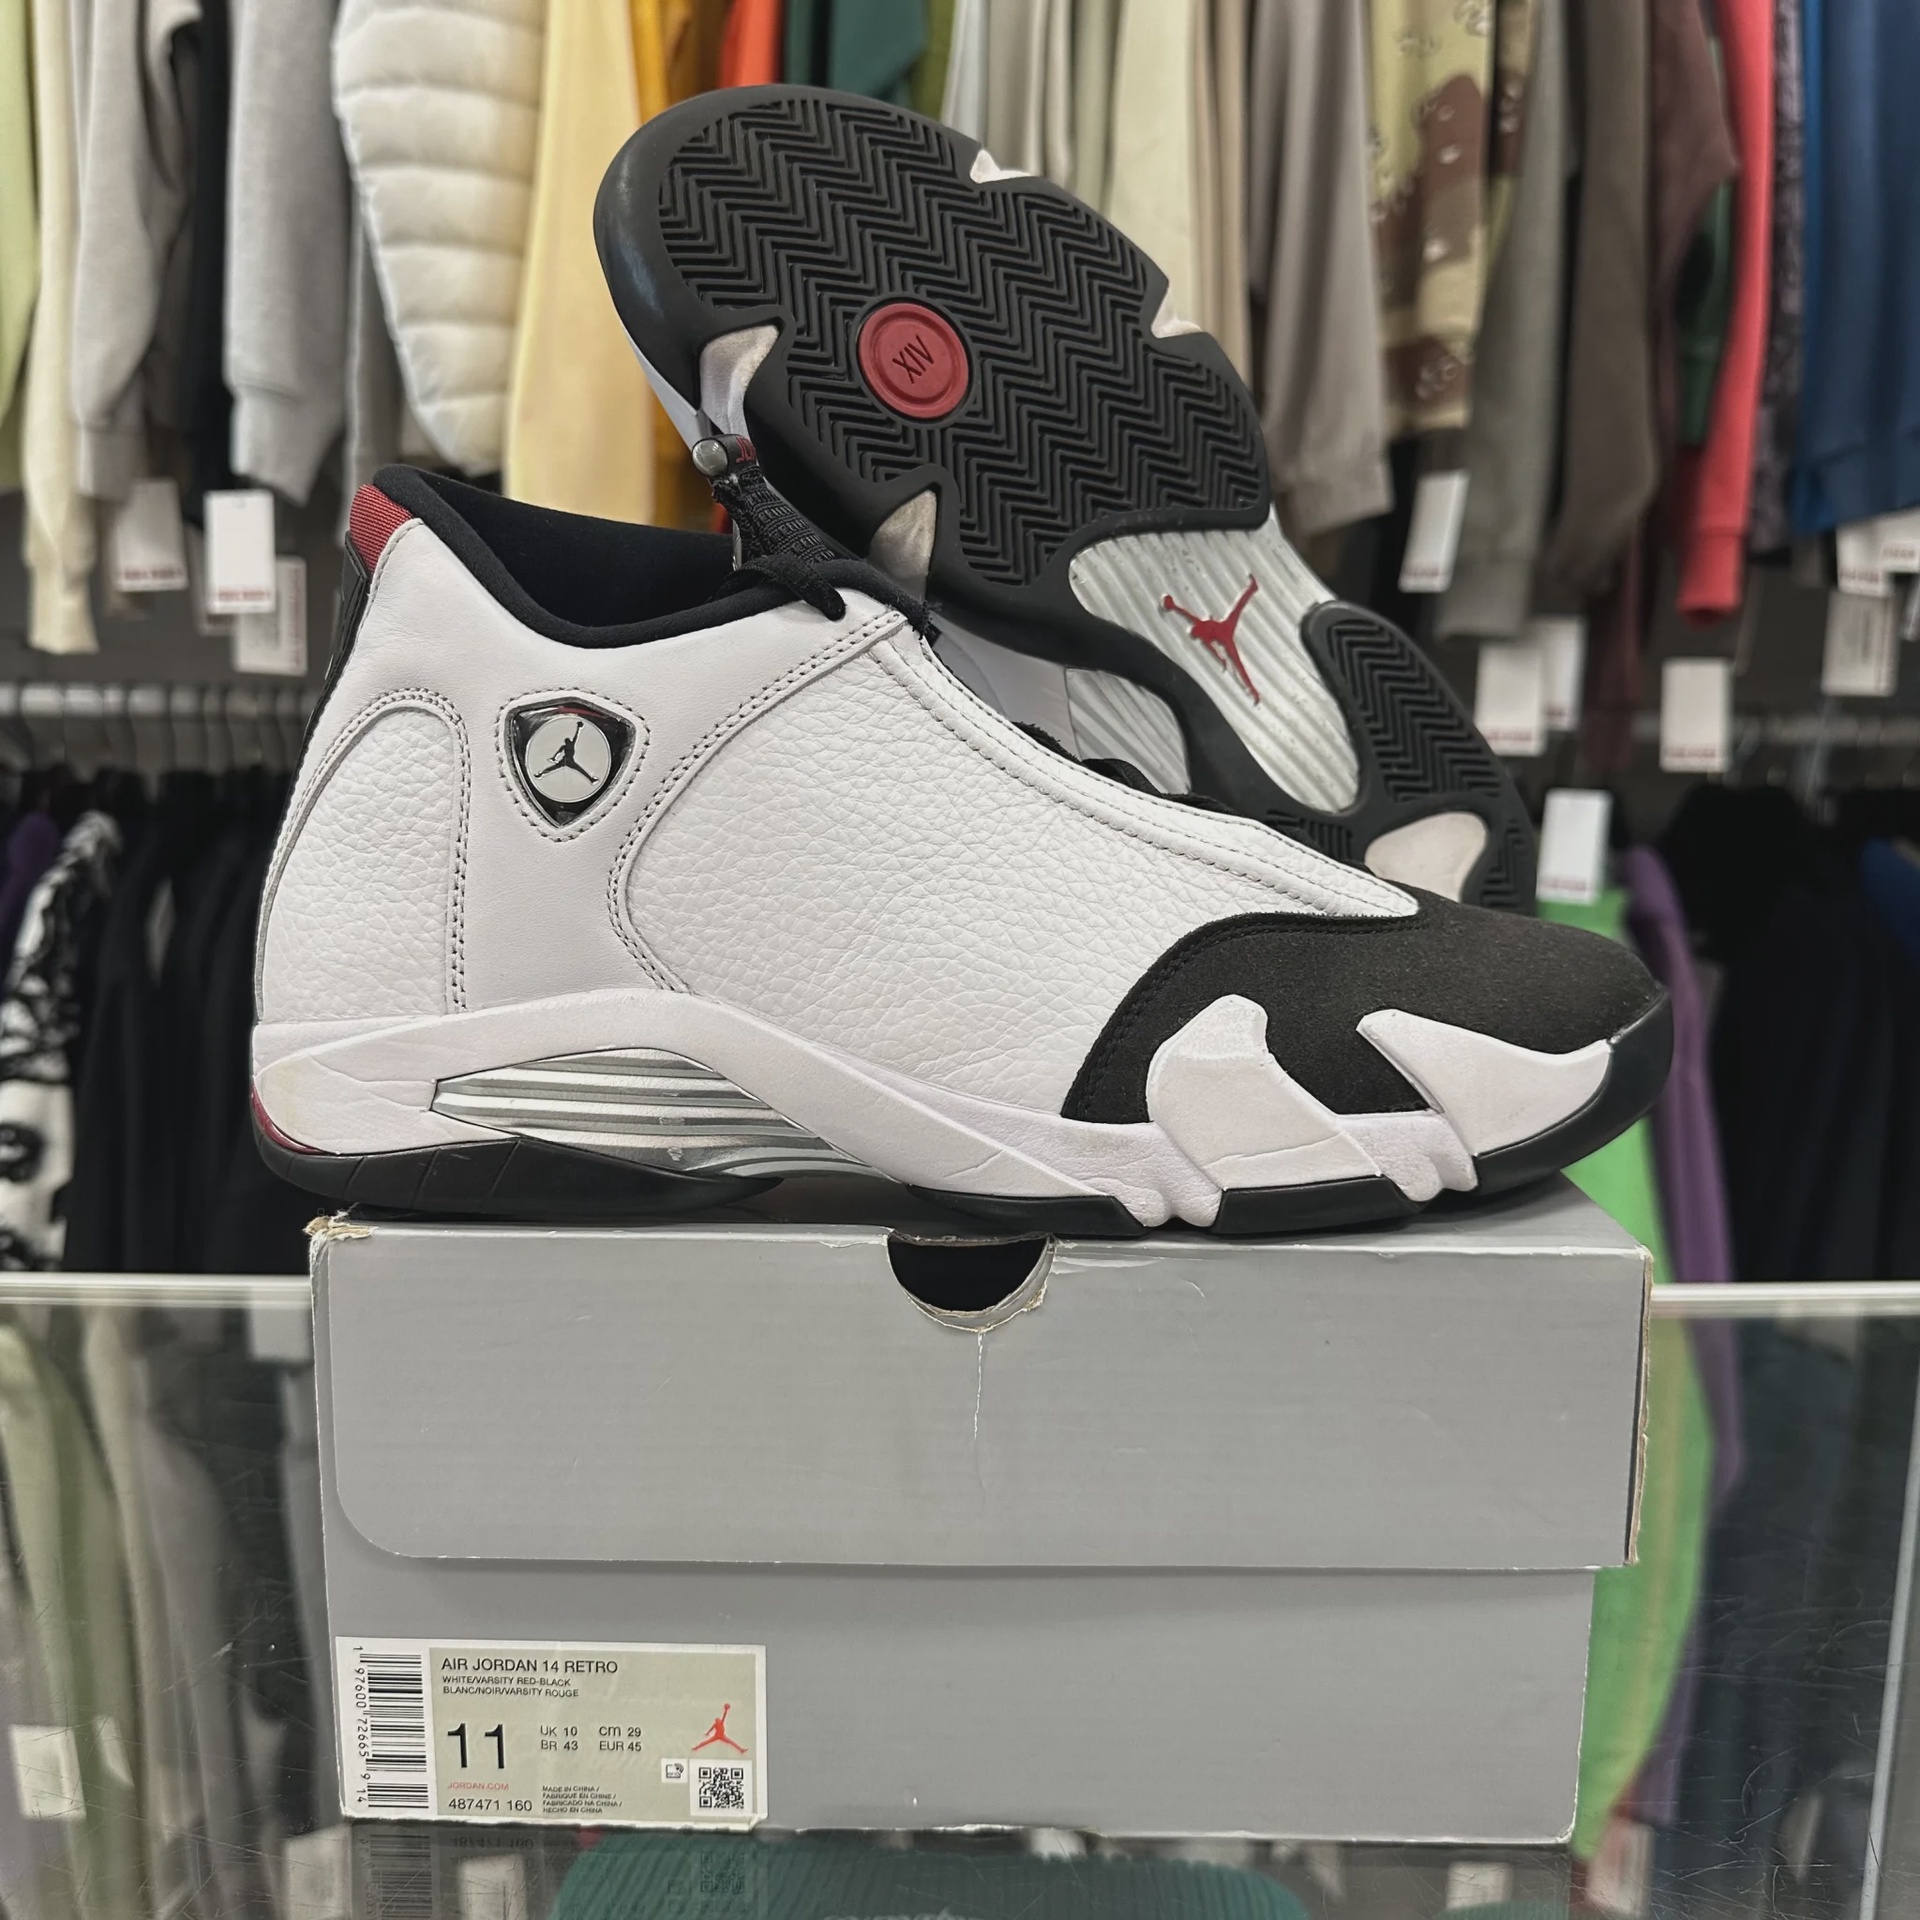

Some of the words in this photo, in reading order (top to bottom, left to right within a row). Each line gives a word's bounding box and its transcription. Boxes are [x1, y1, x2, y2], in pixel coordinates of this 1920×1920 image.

[891, 334, 934, 384] XIV
[441, 1658, 468, 1671] AIR
[472, 1658, 538, 1672] JORDAN
[542, 1660, 559, 1673] 14
[564, 1660, 618, 1673] RETRO
[442, 1675, 514, 1685] WHITE/VARSITY
[517, 1677, 571, 1687] RED-BLACK
[354, 1667, 367, 1708] 97600
[443, 1686, 543, 1696] BLANC/NOIR/VARSITY
[545, 1688, 579, 1698] ROUGE
[540, 1725, 558, 1737] UK
[563, 1726, 578, 1737] 10
[627, 1726, 642, 1738] 29
[357, 1718, 370, 1757] 72665
[447, 1723, 505, 1769] 11
[540, 1740, 558, 1751] BR
[563, 1740, 579, 1751] 43
[599, 1740, 625, 1752] EUR
[627, 1741, 642, 1752] 45
[360, 1772, 371, 1780] 9
[448, 1781, 509, 1791] JORDAN.COM
[356, 1788, 367, 1803] 14
[448, 1798, 501, 1811] 487471
[507, 1799, 533, 1812] 160
